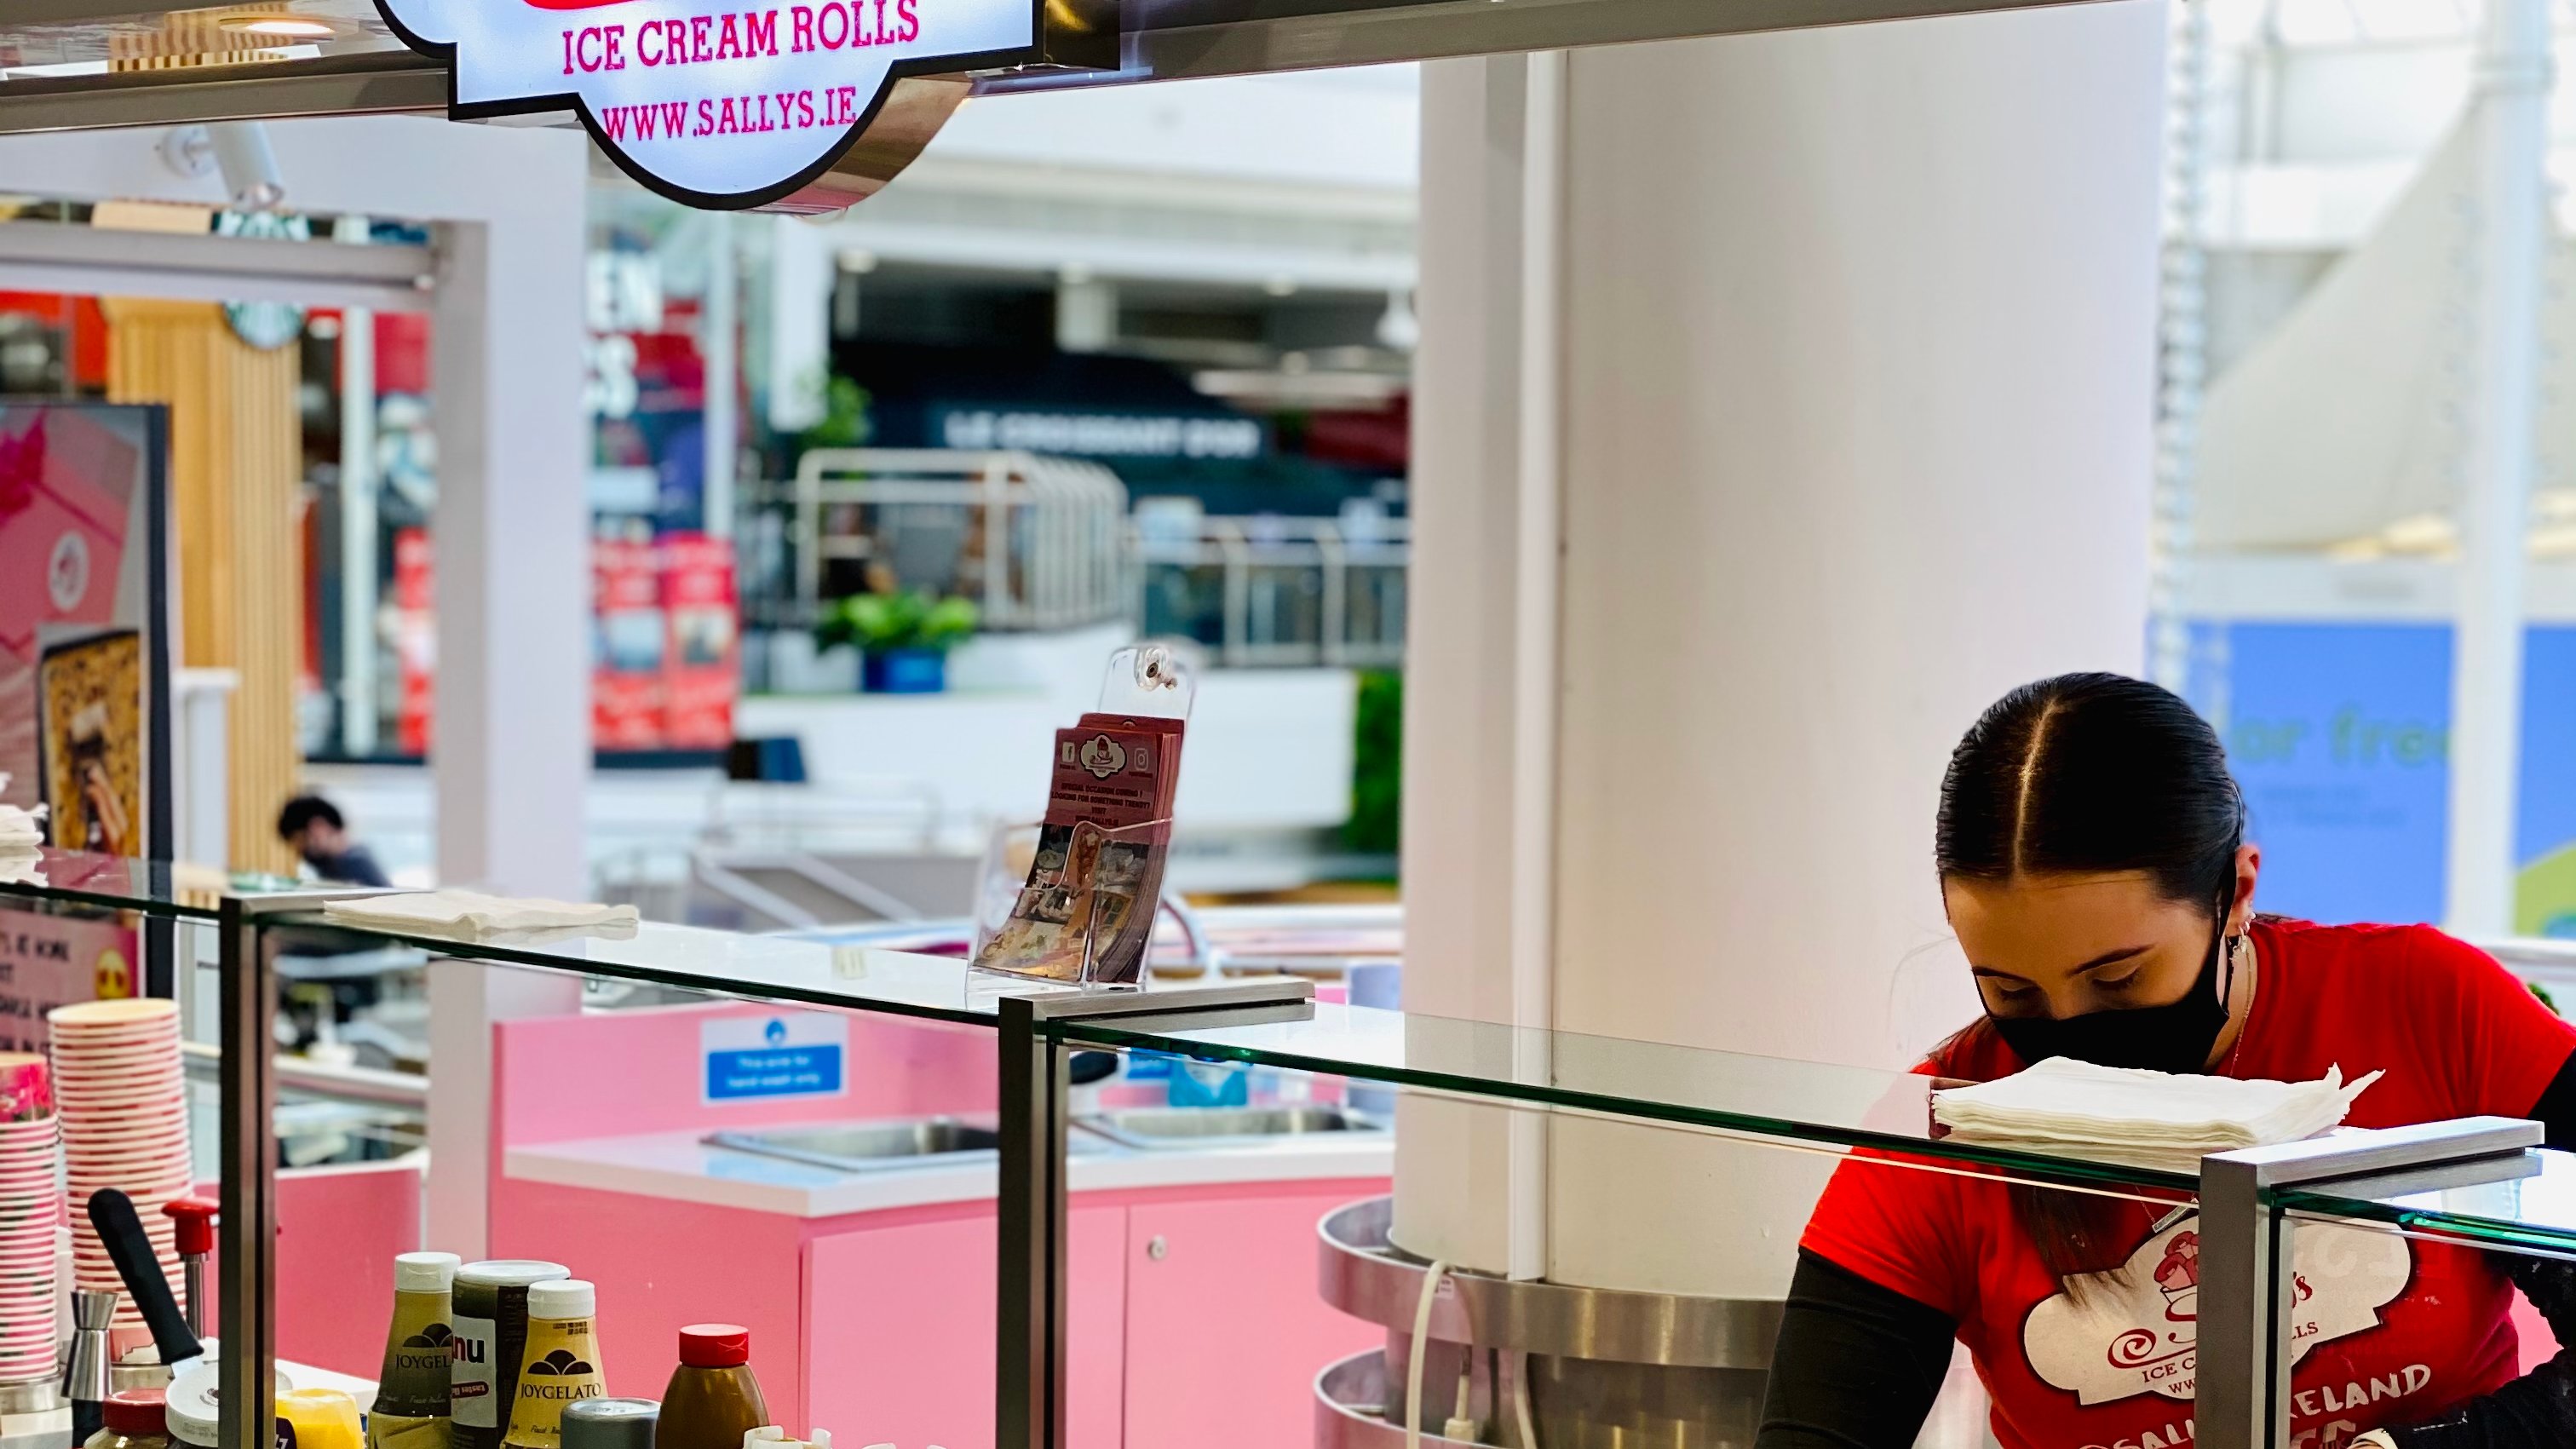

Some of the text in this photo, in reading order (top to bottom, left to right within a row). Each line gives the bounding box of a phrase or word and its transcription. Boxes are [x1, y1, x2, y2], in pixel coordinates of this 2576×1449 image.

[562, 0, 918, 75] ICE CREAM ROLLS
[601, 86, 857, 141] WWW.SALLYS.IE
[2331, 702, 2451, 766] fre
[1078, 795, 1089, 803] FOR
[395, 1354, 451, 1370] JOYGEL
[2142, 1363, 2177, 1383] ICE
[520, 1382, 601, 1400] JOYGELATO
